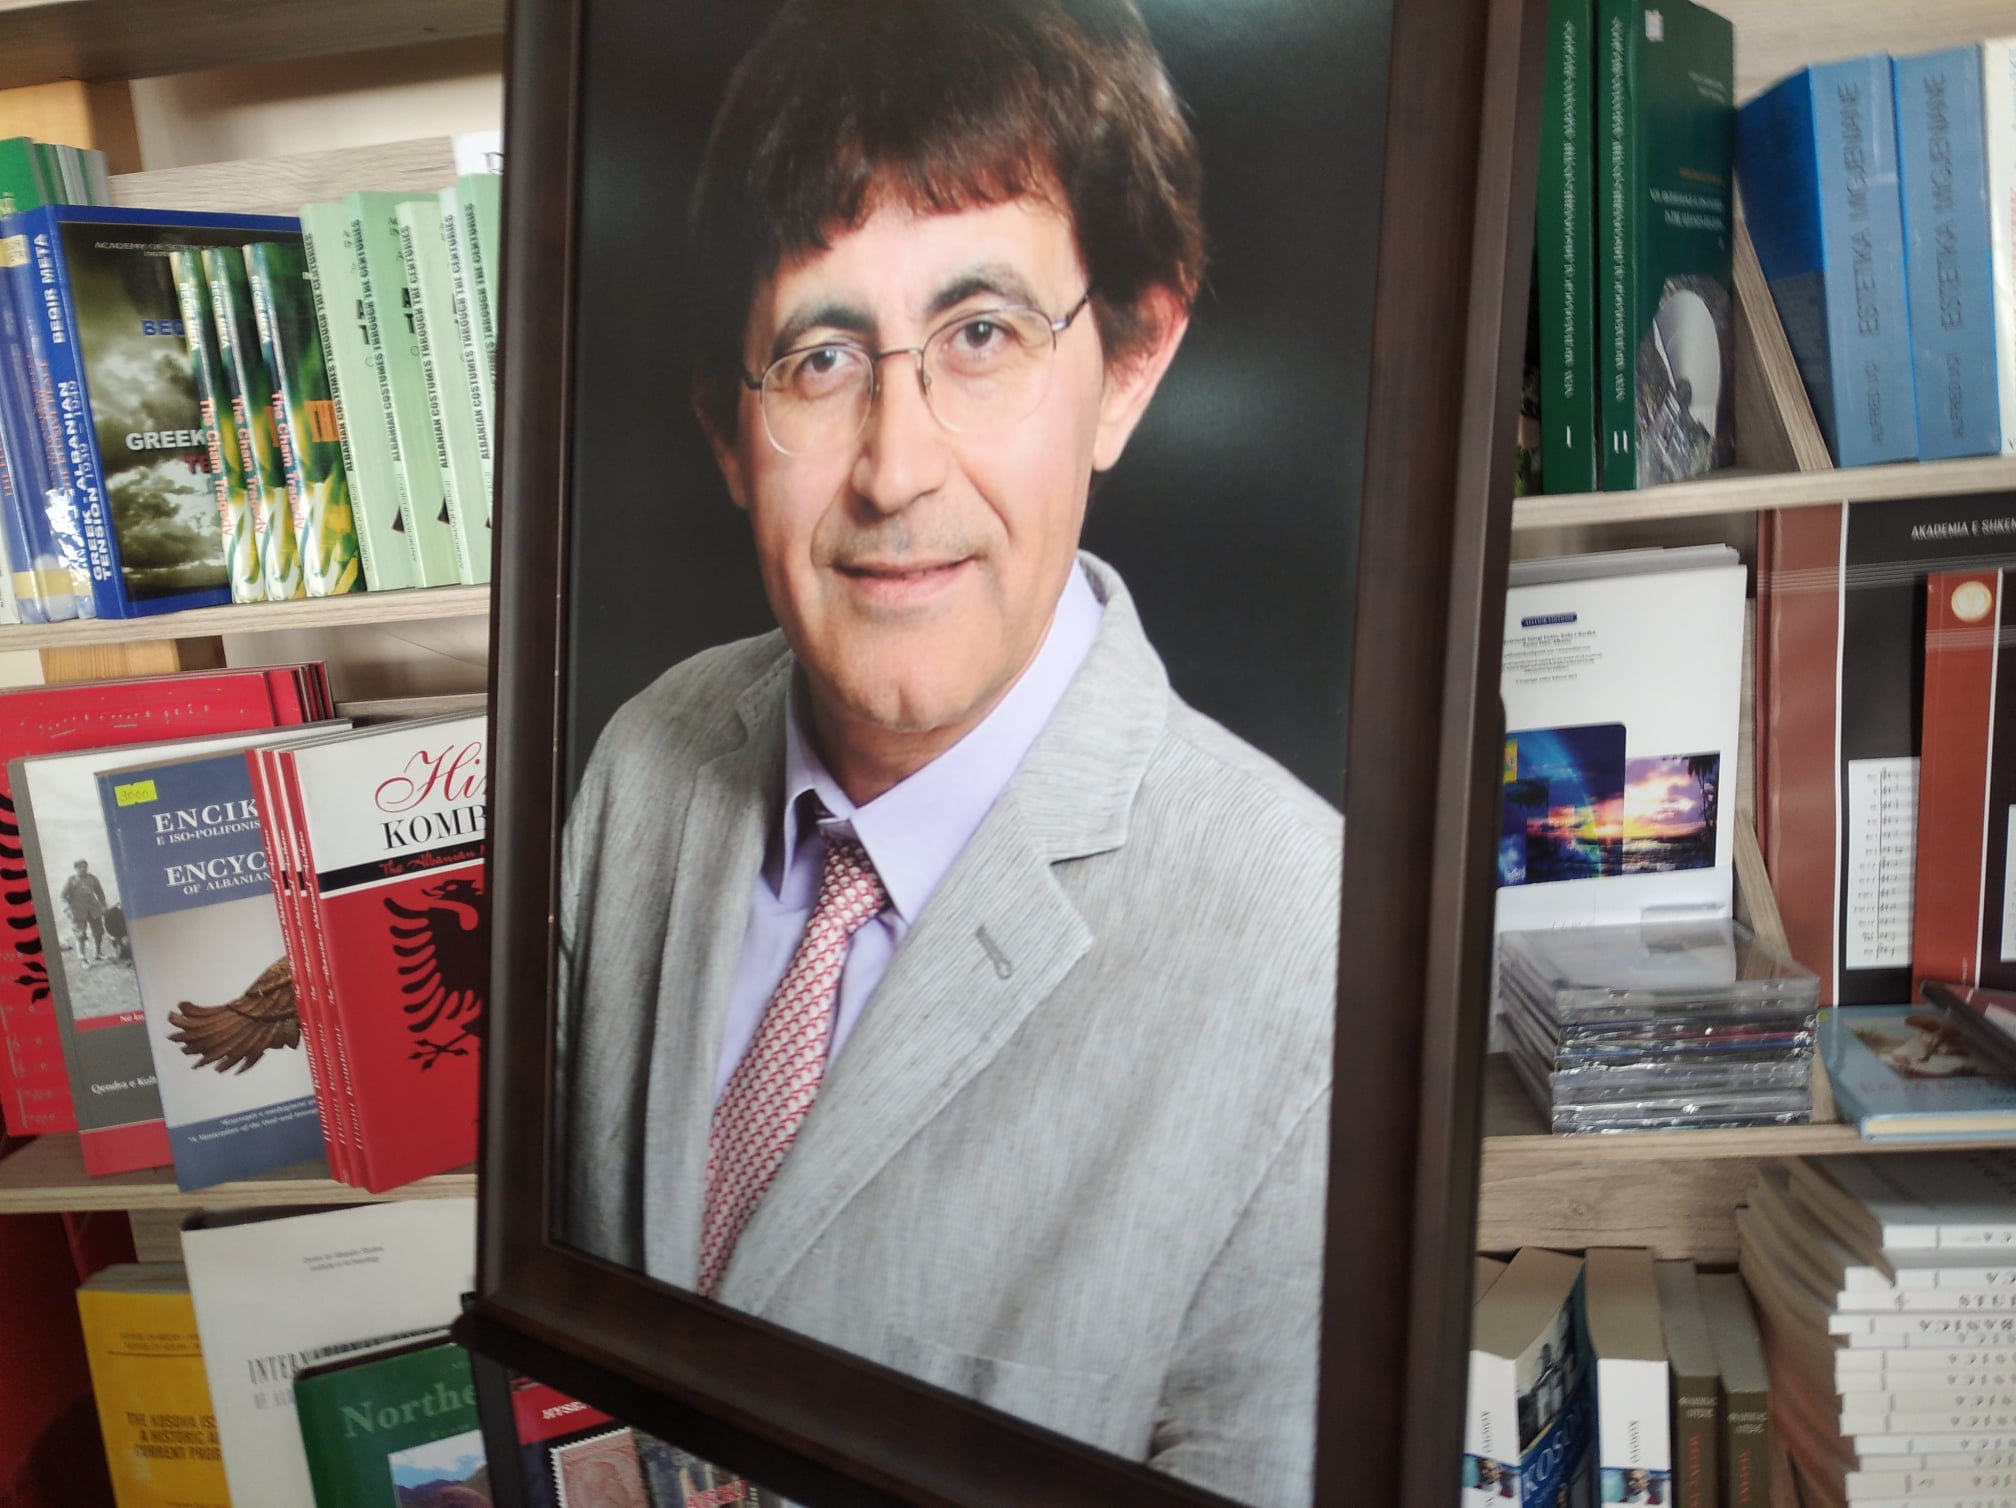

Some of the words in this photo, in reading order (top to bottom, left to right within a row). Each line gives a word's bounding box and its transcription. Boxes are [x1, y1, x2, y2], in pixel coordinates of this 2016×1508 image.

[33, 233, 56, 284] META
[44, 287, 66, 343] BEQIR
[58, 382, 88, 491] ALBANIAN
[125, 428, 206, 451] GREEK
[82, 511, 104, 581] GREEK
[86, 487, 112, 581] TENSION
[1911, 521, 1969, 541] AKADEMIA
[375, 741, 487, 814] Hi
[151, 798, 260, 834] ENCIK
[156, 836, 166, 846] E
[164, 850, 268, 887] ENCYC
[379, 858, 404, 877] The
[183, 883, 201, 896] OF
